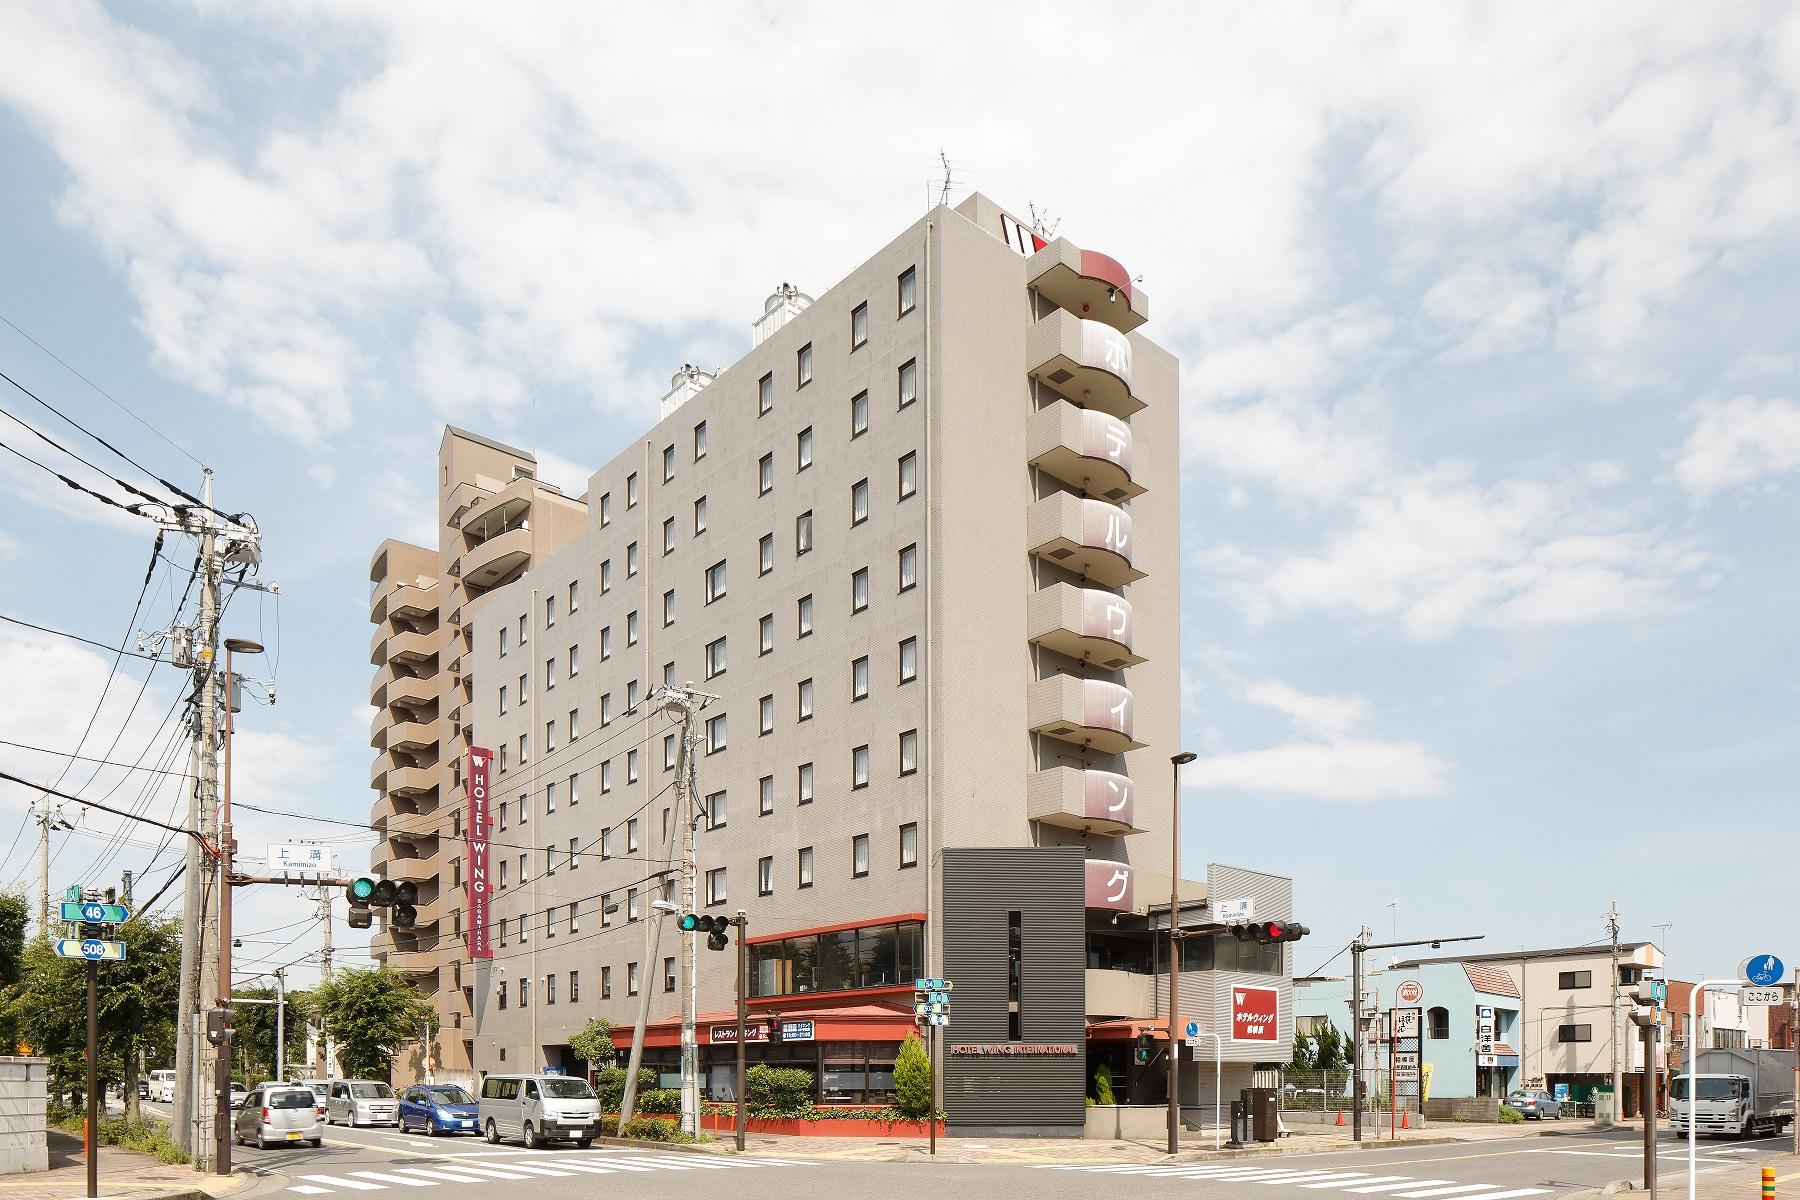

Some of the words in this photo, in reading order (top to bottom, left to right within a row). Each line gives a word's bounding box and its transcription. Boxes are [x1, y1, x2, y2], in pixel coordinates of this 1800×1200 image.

[474, 773, 485, 836] HOTEL
[283, 860, 317, 868] Kamimizo
[472, 841, 486, 892] WING
[85, 906, 102, 919] 46
[83, 943, 104, 956] 508
[1746, 991, 1779, 1002] ここから
[951, 1045, 980, 1055] HOTEL
[981, 1045, 1011, 1055] WING
[1014, 1045, 1077, 1055] INTERNATIONAL
